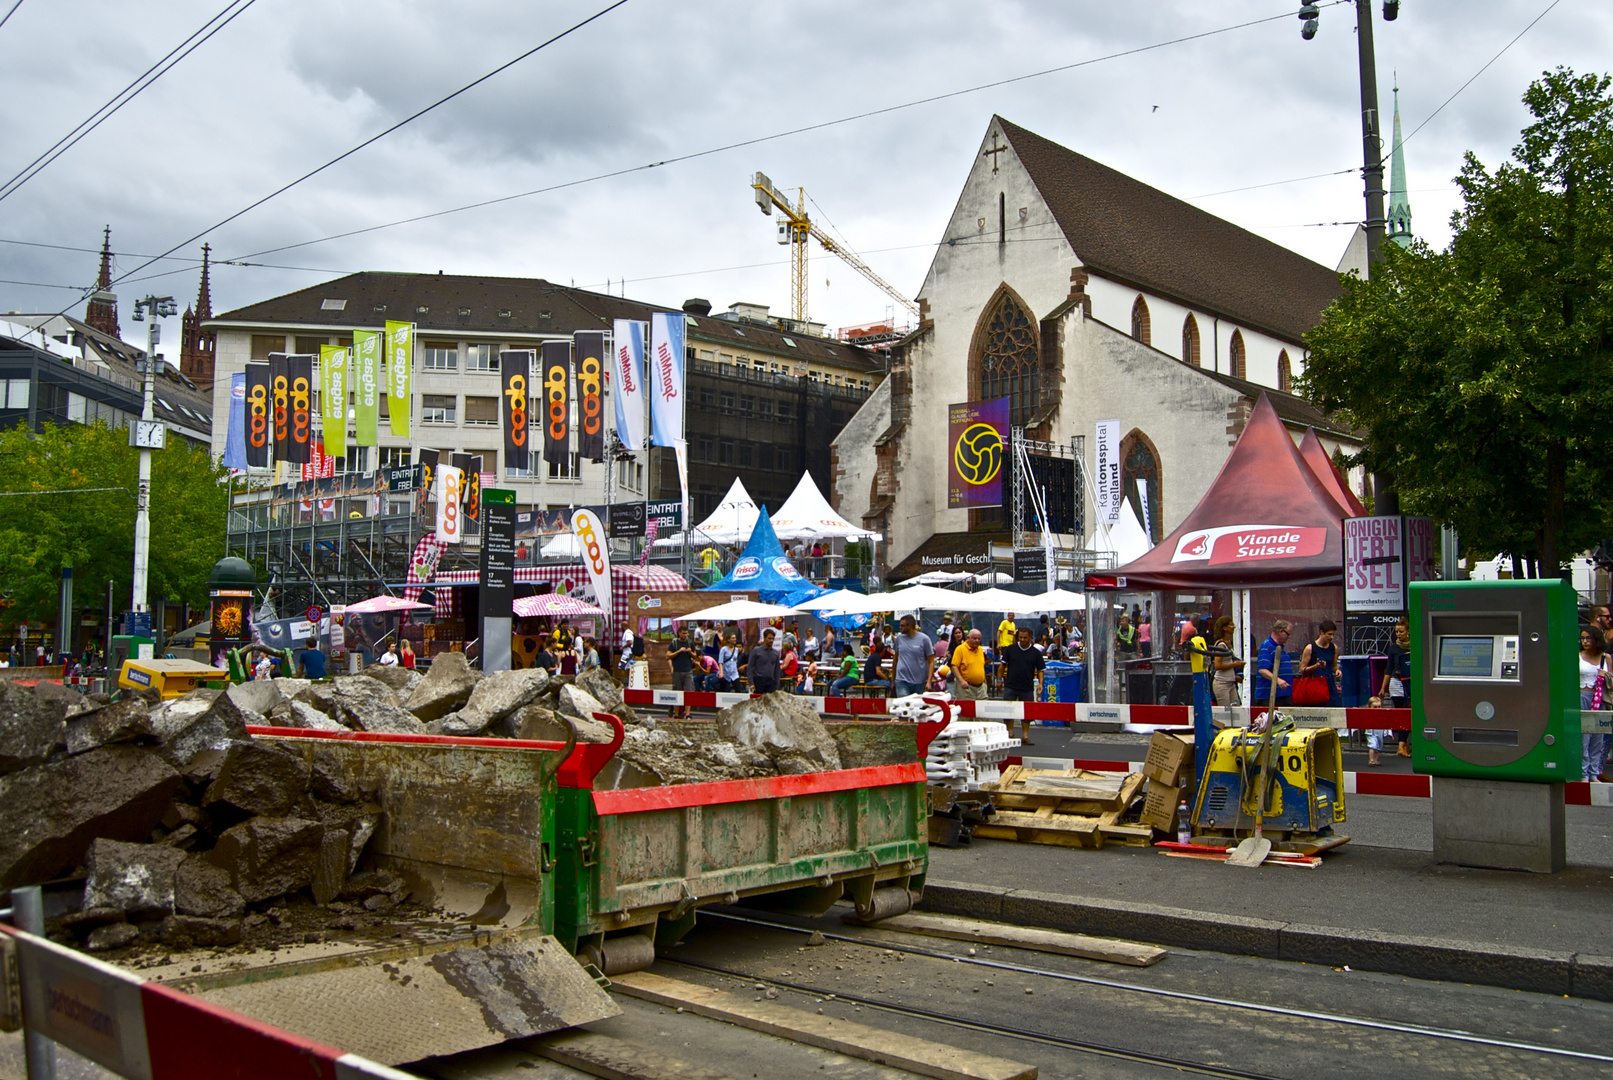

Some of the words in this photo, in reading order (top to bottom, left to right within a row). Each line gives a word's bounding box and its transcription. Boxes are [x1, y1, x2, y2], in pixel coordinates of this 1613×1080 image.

[1098, 424, 1108, 508] Kantonsspital
[1108, 463, 1120, 520] Baselland
[444, 474, 458, 535] coop
[1236, 532, 1300, 546] Viande
[1346, 536, 1398, 562] LIEBT
[922, 556, 952, 565] Museum
[954, 554, 964, 564] für
[1236, 544, 1297, 558] Suisse
[735, 566, 757, 574] Frisco
[1347, 561, 1400, 589] ESEL
[1280, 755, 1302, 772] 10
